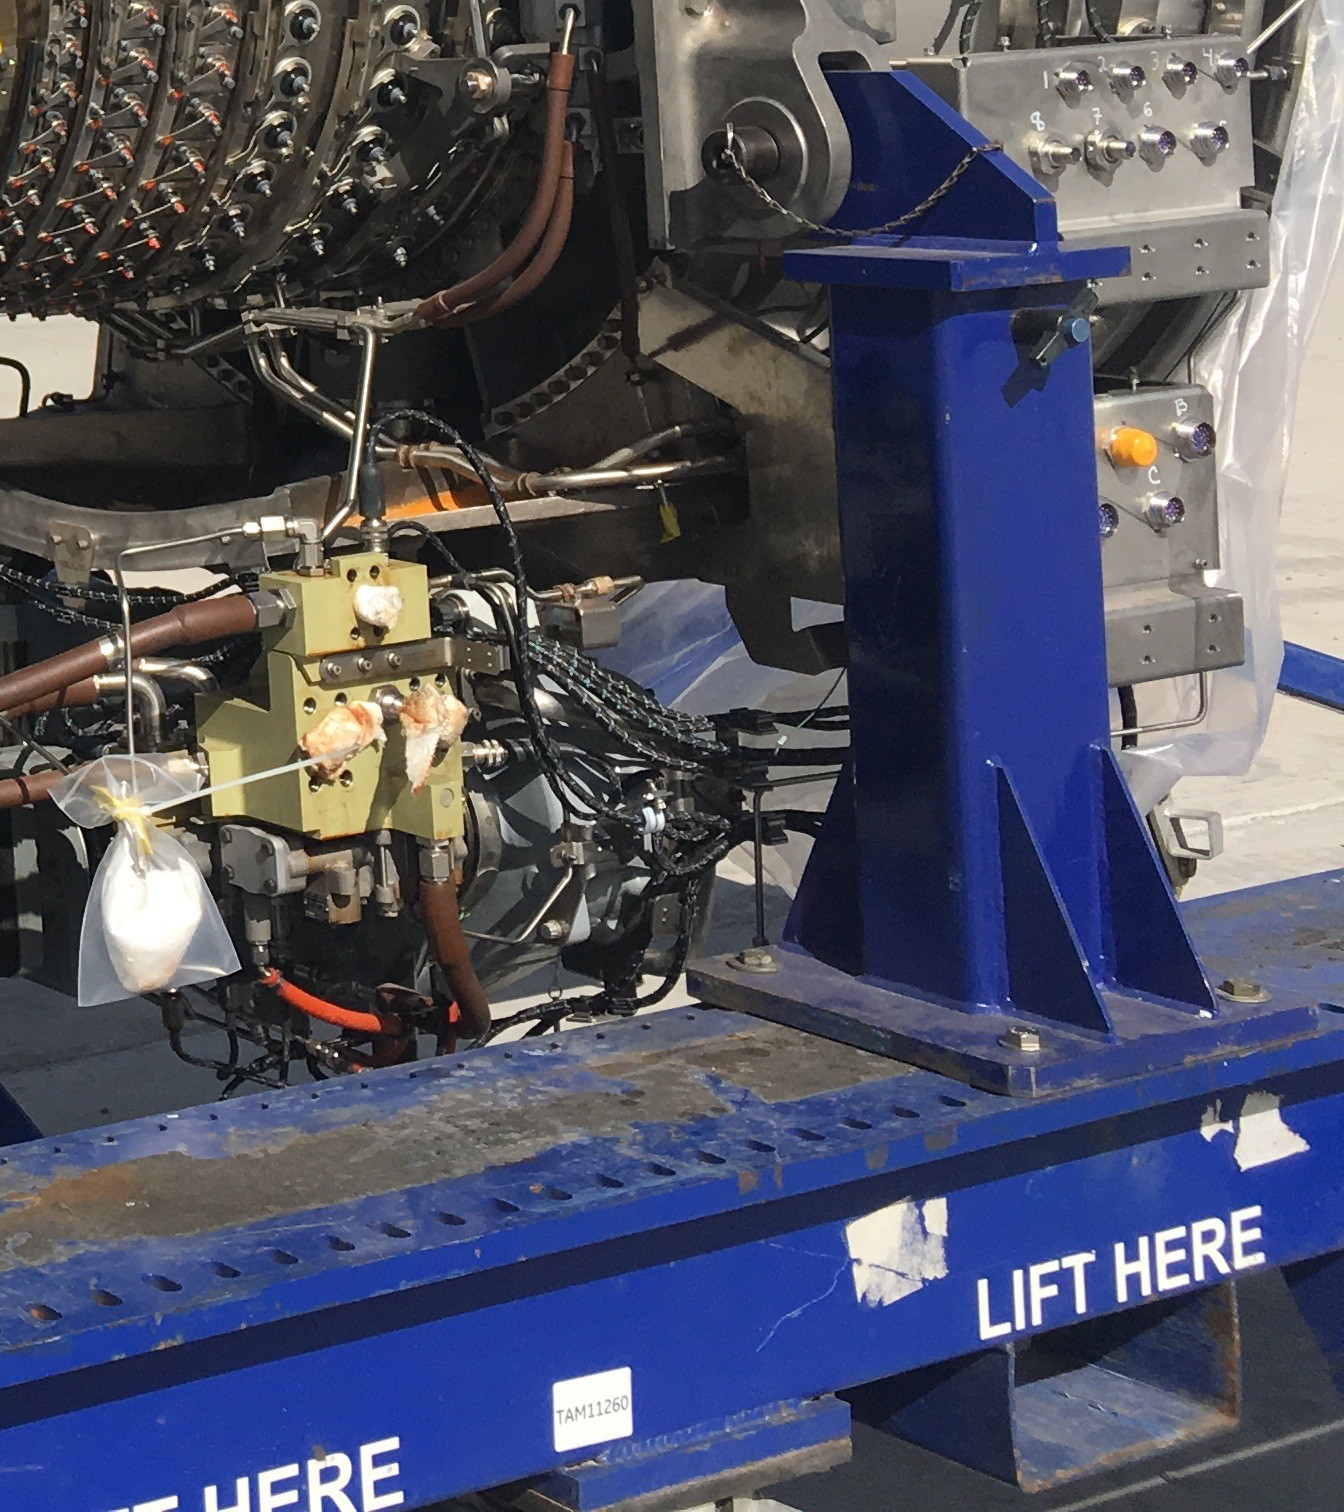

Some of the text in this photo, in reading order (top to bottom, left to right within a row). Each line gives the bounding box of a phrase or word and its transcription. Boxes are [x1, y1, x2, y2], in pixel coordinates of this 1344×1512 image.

[1097, 56, 1108, 73] 2
[1150, 51, 1160, 71] 3
[1202, 48, 1213, 66] 4
[1043, 70, 1049, 90] 1
[1092, 107, 1102, 125] 7
[1143, 101, 1153, 117] 6
[1030, 111, 1045, 131] 8
[1148, 466, 1161, 485] C
[977, 1204, 1265, 1340] LIFT HERE
[556, 1394, 629, 1426] TAM11260
